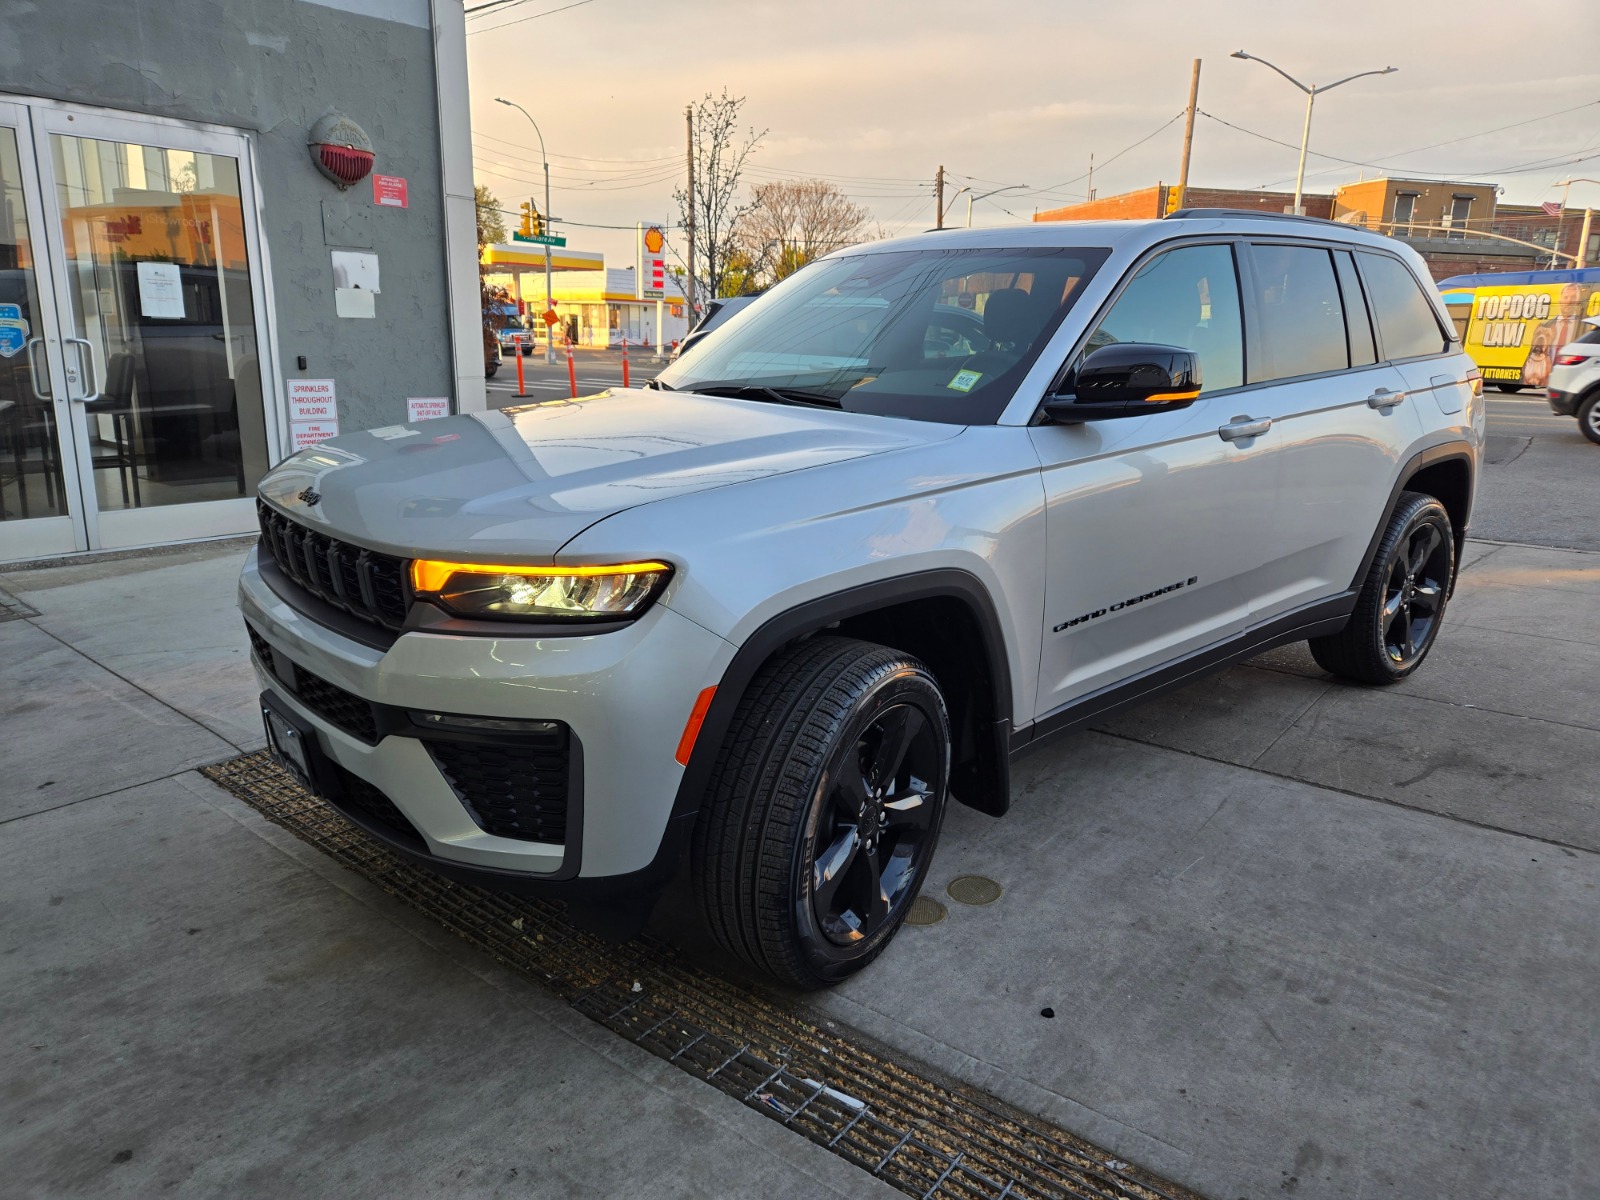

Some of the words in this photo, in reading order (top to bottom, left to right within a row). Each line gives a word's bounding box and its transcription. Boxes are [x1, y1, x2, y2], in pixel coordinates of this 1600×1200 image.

[1477, 294, 1551, 320] TOPDOG
[1483, 322, 1526, 347] LAW
[1484, 369, 1521, 380] ATTORNEYS
[294, 385, 329, 393] SPRINKLERS
[291, 396, 333, 404] THROUGHOUT
[299, 407, 328, 415] BUILDING
[1053, 608, 1107, 633] GRAND
[1109, 580, 1186, 612] CHEROKEE
